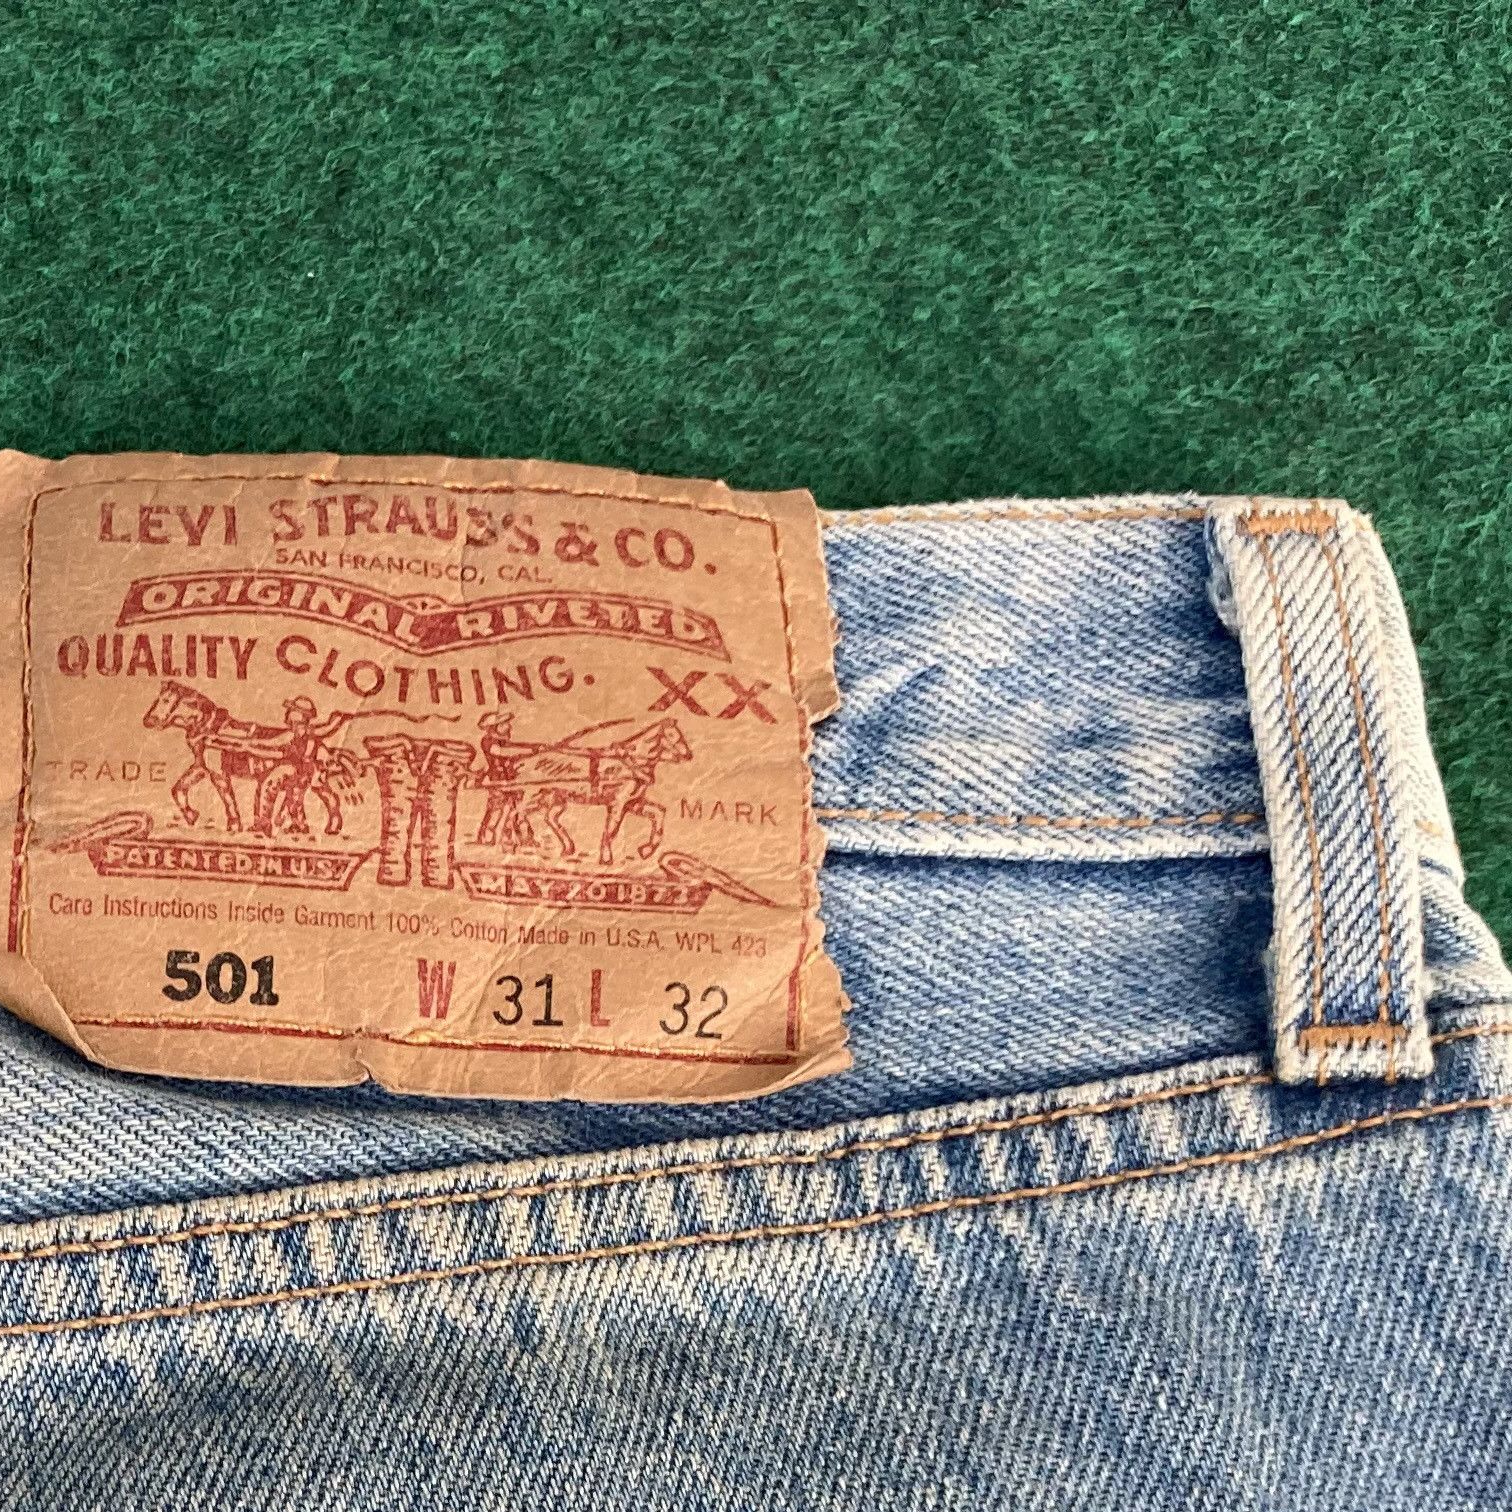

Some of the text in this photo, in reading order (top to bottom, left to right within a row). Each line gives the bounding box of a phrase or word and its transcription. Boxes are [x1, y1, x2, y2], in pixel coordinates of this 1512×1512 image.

[99, 494, 717, 576] LEVI STRAUSS & CO.
[276, 547, 327, 569] SAN
[338, 553, 486, 585] FRANCISCO,
[142, 578, 707, 642] ORIGINAL RIVETED
[57, 633, 596, 705] QUALITY CLOTHING.
[646, 666, 778, 724] XX
[45, 761, 167, 783] TRADE
[679, 799, 780, 827] MARK
[105, 846, 252, 875] PATENTED
[481, 872, 554, 898] MAY
[49, 893, 93, 916] Care
[103, 895, 219, 921] Instructions
[228, 900, 285, 924] Inside
[294, 905, 378, 931] Garment
[387, 912, 439, 937] 100%
[450, 917, 509, 945] Cotton
[518, 926, 570, 946] Made
[579, 928, 596, 947] in
[675, 932, 723, 955] WPL
[161, 949, 280, 1007] 501
[416, 957, 729, 1040] W 31 L 32
